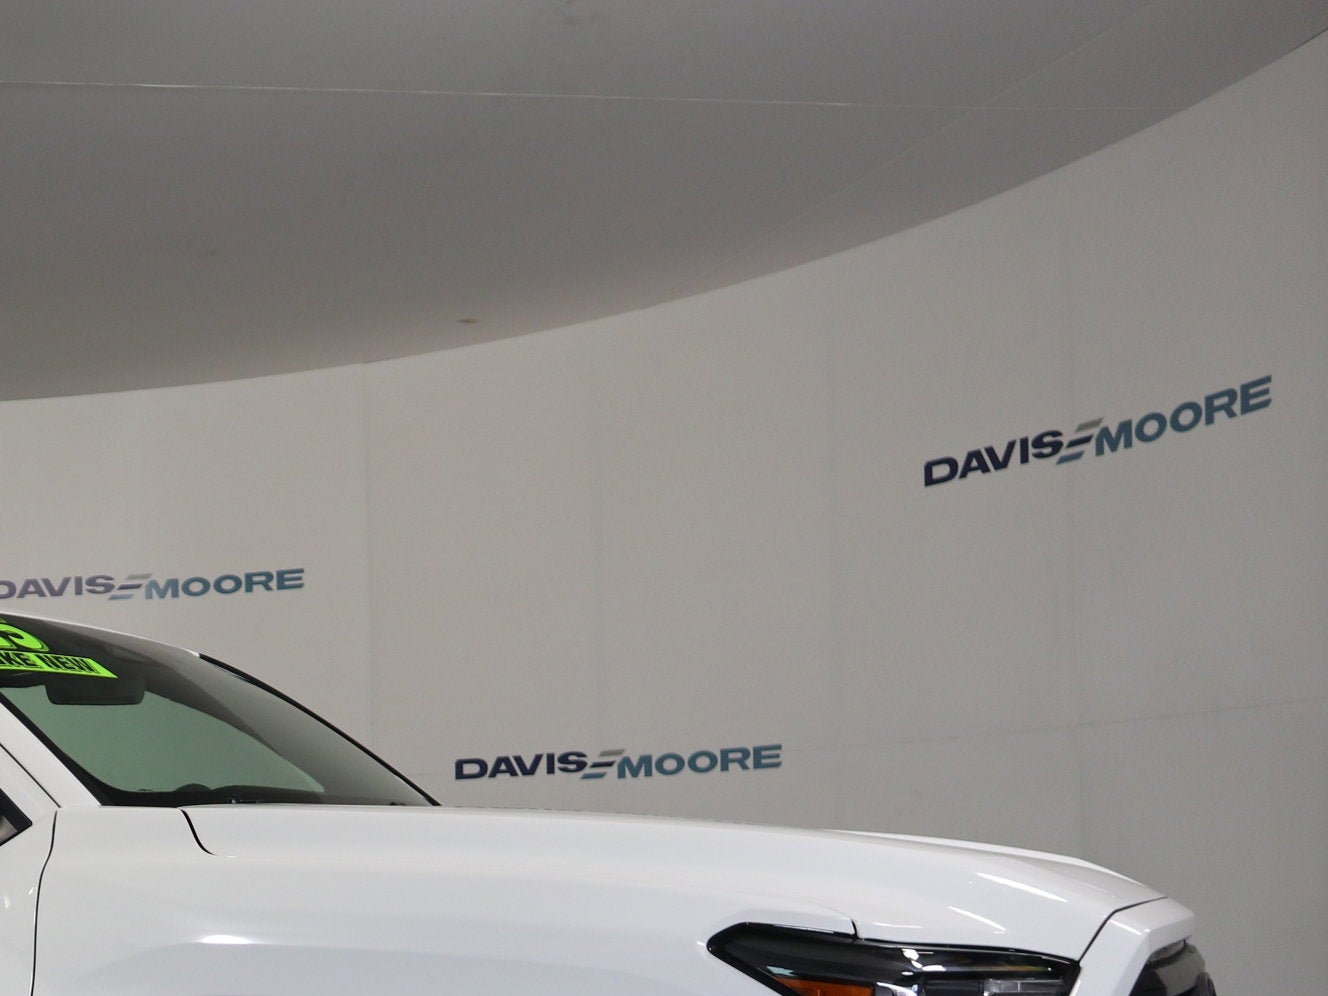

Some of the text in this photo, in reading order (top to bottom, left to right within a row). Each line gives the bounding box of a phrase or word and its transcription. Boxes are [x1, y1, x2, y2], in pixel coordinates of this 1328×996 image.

[924, 374, 1272, 488] DAVIS MOORE
[144, 568, 304, 600] MOORE
[34, 653, 100, 674] NEW
[455, 744, 782, 780] DAVIS MOORE
